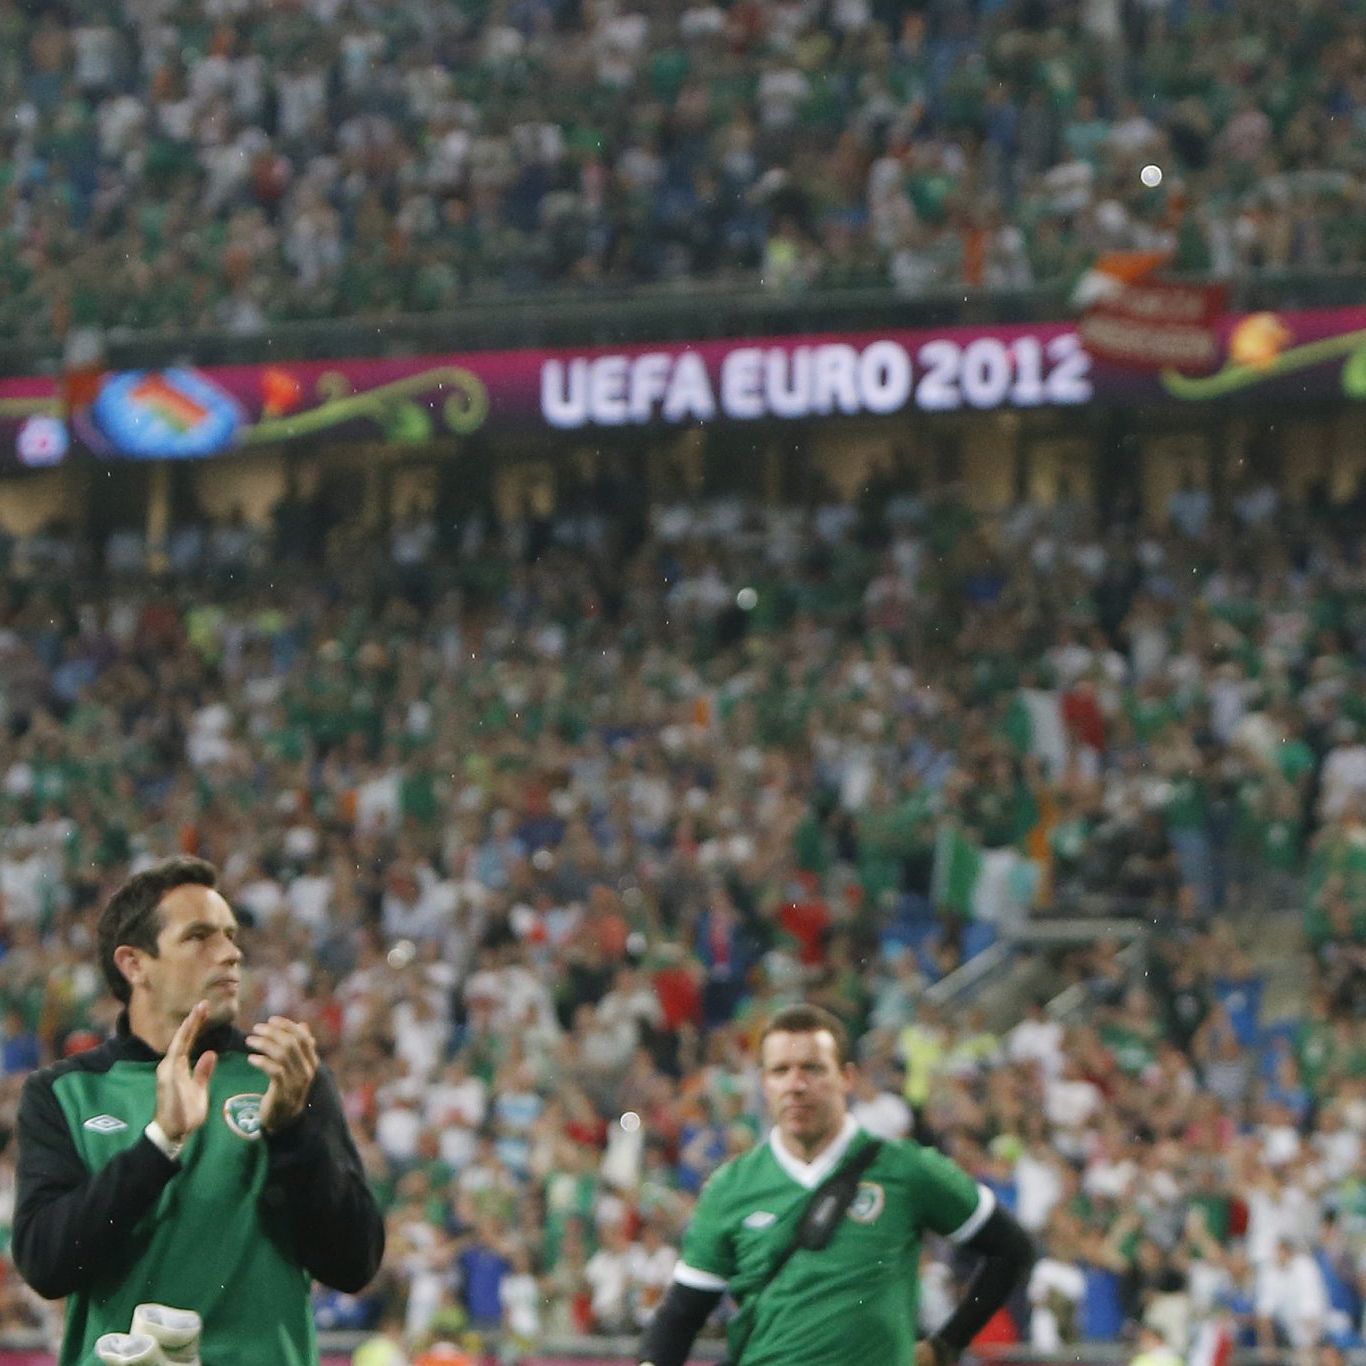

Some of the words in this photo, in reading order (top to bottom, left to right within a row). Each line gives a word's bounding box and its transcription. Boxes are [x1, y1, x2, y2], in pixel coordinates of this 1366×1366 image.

[540, 351, 717, 429] UEFA
[720, 340, 914, 420] EURO
[916, 332, 1093, 411] 2012
